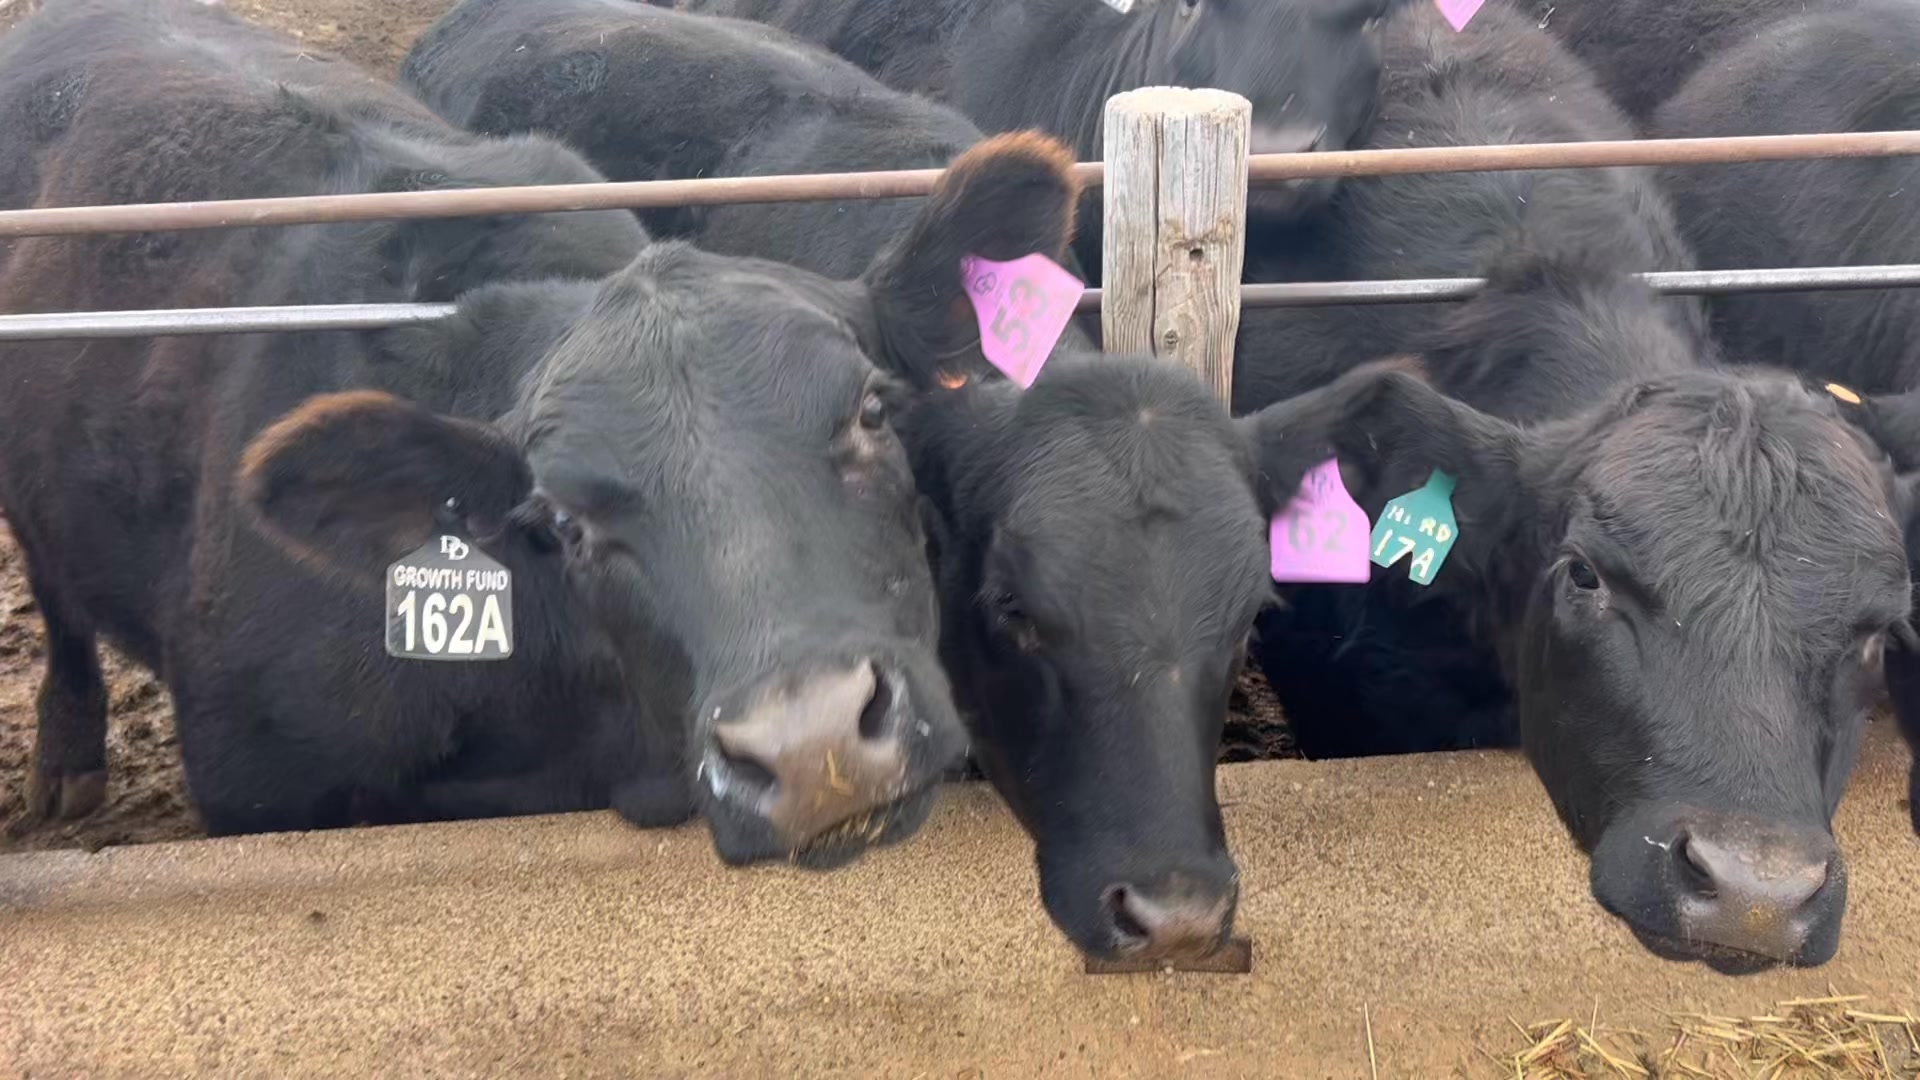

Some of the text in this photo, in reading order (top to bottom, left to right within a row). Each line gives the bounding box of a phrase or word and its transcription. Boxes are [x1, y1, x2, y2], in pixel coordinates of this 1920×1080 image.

[990, 276, 1050, 353] 53
[1287, 506, 1351, 552] 62
[1373, 529, 1435, 579] 17A
[393, 564, 509, 591] GROWTH FUND
[397, 589, 510, 654] 162A
